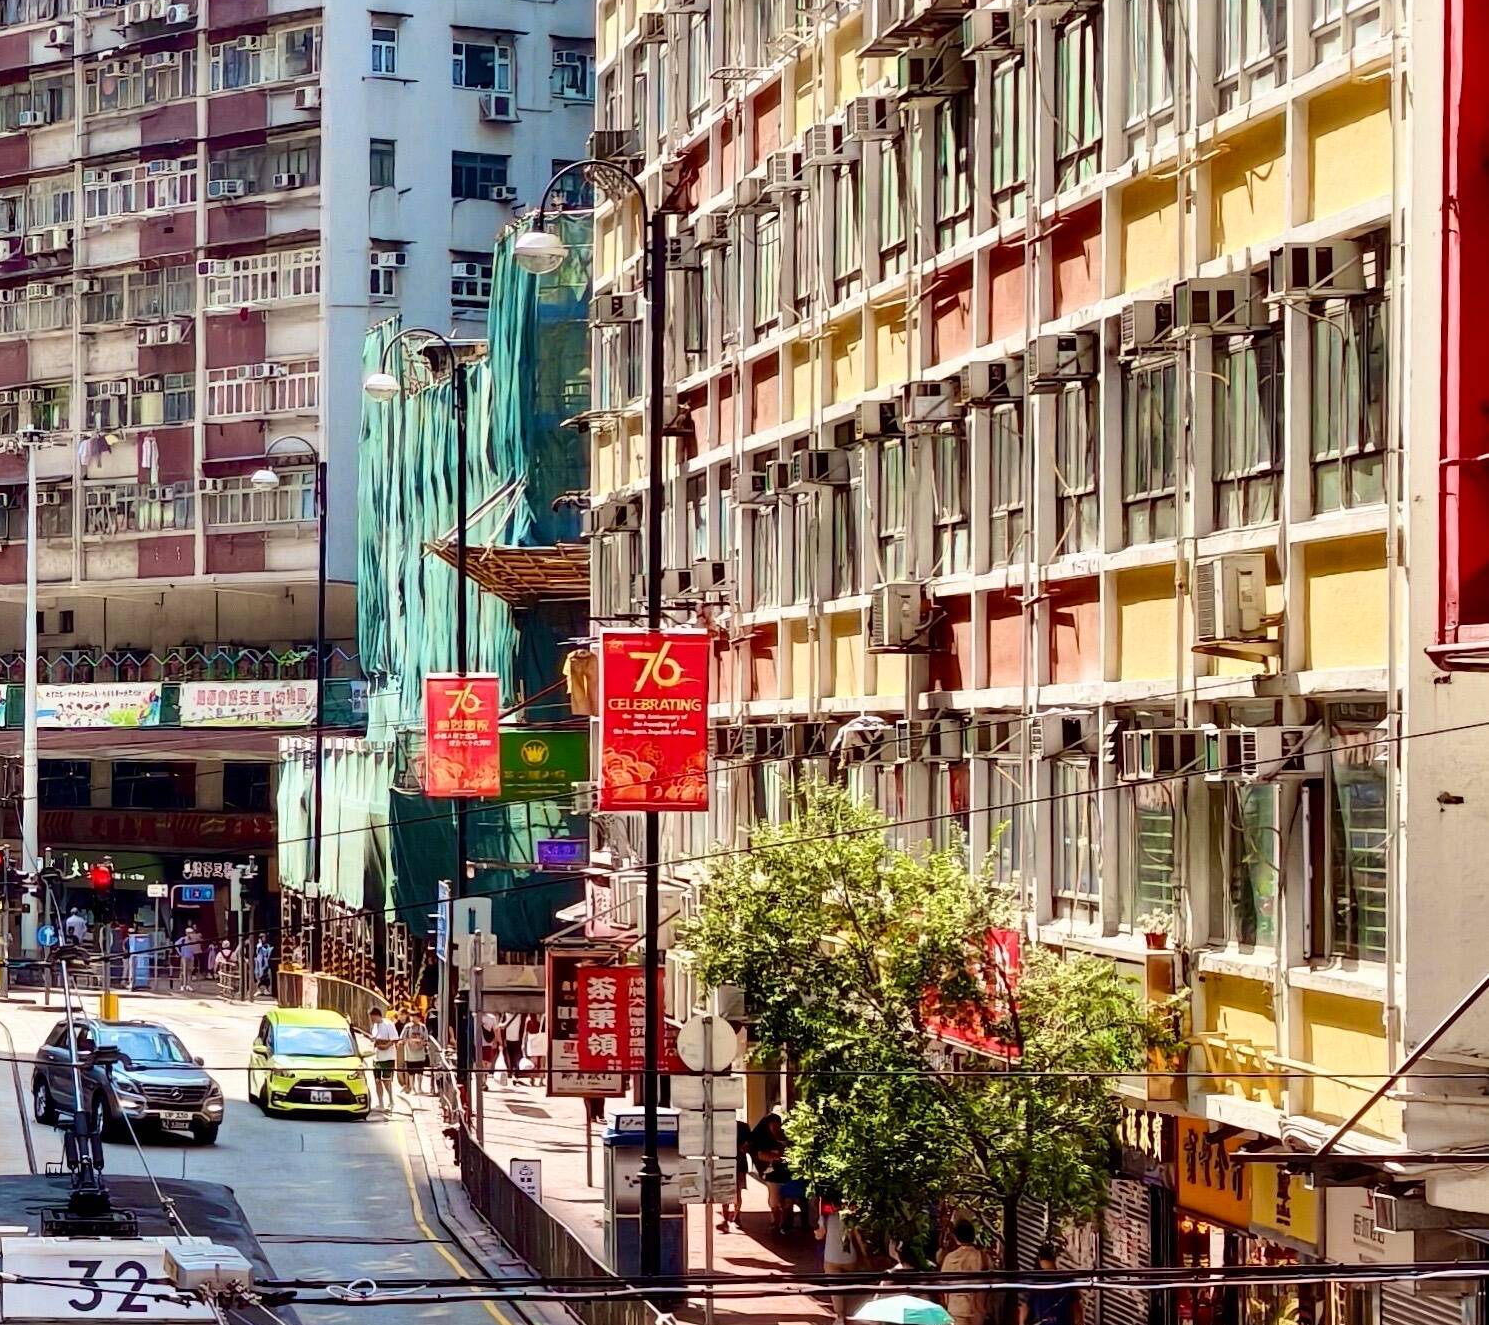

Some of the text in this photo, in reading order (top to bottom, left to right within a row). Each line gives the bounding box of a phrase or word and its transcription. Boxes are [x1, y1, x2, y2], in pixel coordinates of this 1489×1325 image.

[628, 641, 684, 693] 76
[445, 683, 481, 718] 76
[607, 698, 702, 712] CELEBRATING
[68, 1259, 149, 1313] 32
